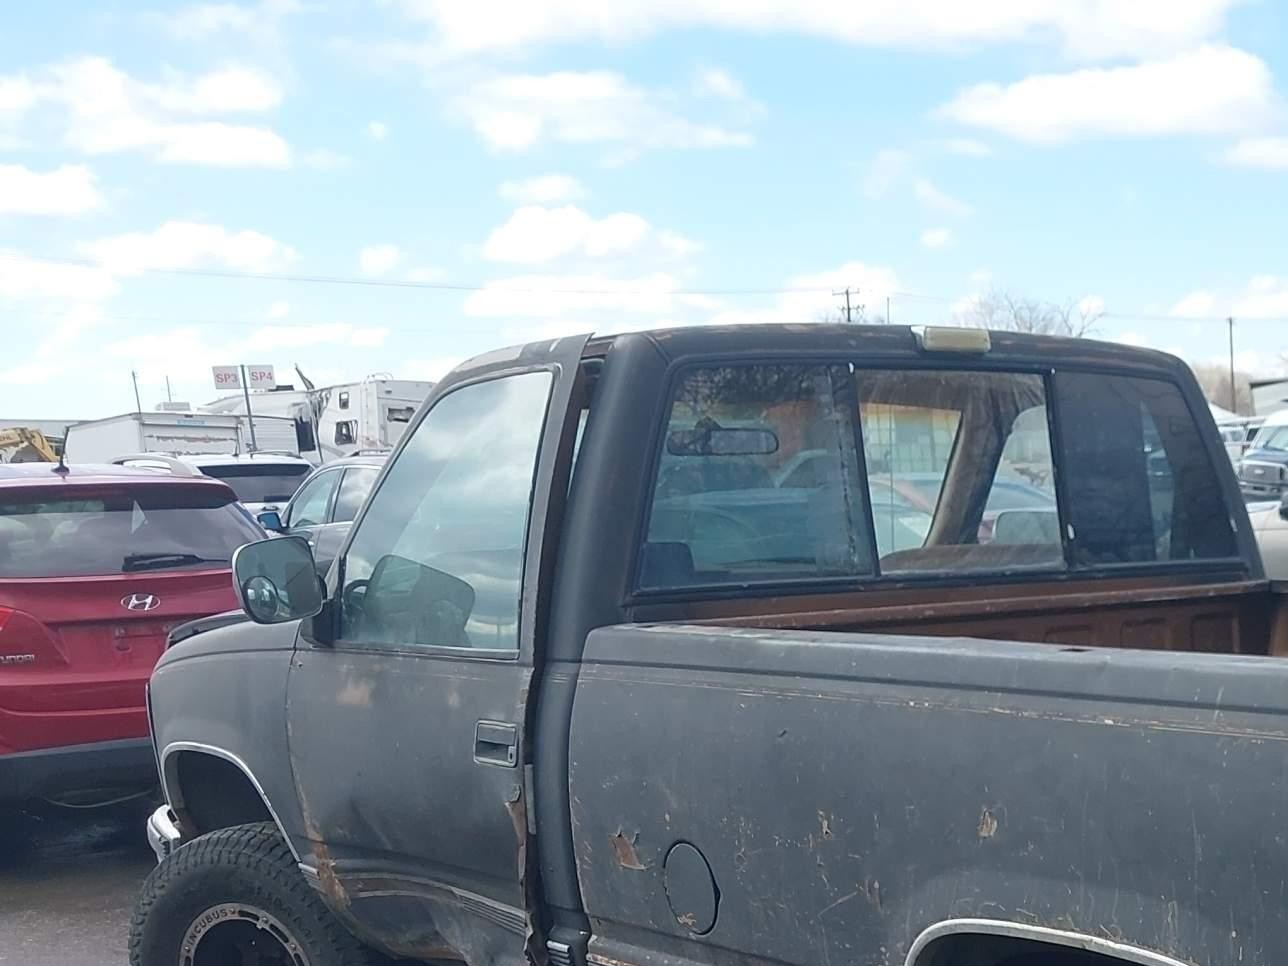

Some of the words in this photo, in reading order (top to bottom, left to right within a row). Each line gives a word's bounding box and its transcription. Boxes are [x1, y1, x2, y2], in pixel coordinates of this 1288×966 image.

[215, 372, 238, 384] SP3
[251, 371, 273, 382] SP4
[187, 909, 228, 945] INCUBUS
